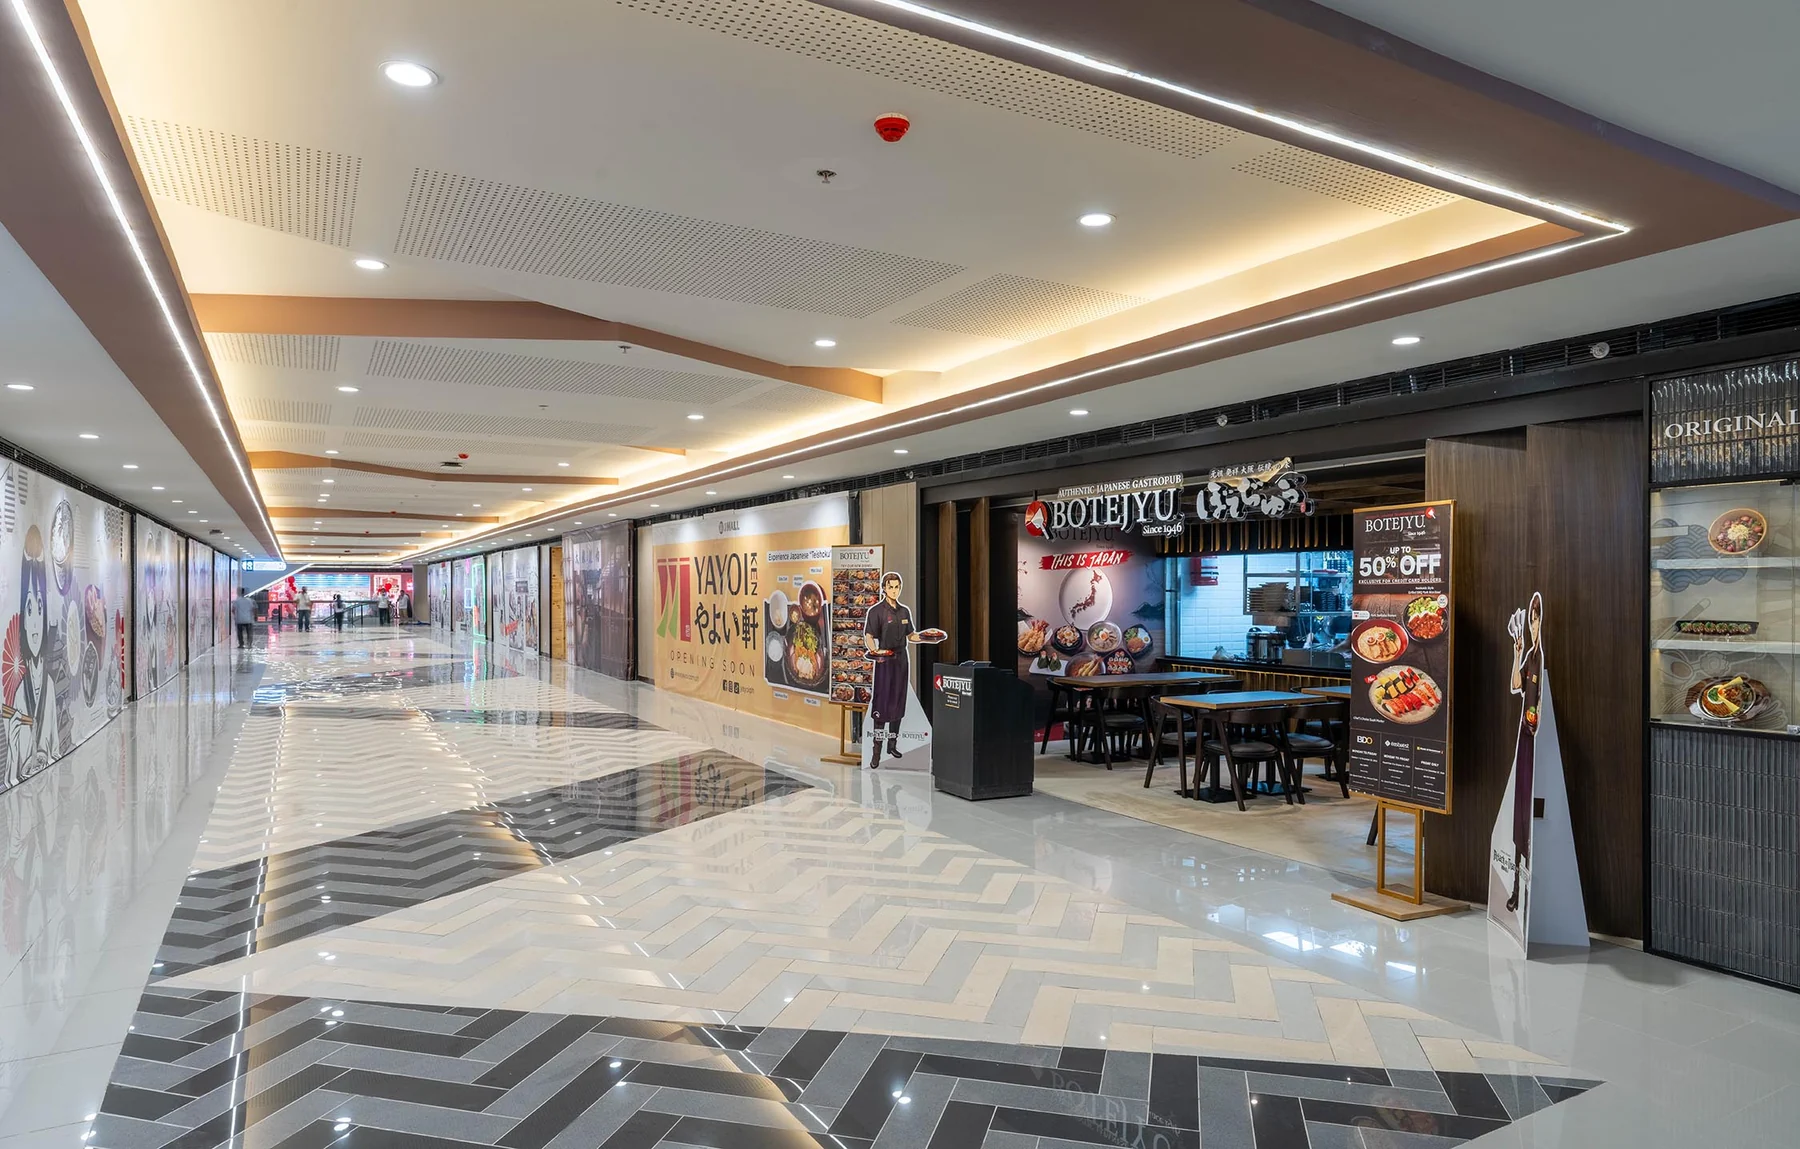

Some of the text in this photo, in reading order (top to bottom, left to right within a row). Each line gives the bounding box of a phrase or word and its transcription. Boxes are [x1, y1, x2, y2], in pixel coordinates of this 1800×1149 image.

[1665, 409, 1800, 439] ORIGINAL
[1058, 474, 1182, 498] AUTHENTIC JAPANESE GASTROPUB
[1142, 522, 1182, 536] Since 1946
[1051, 551, 1124, 569] THIS IS JAPAN
[1401, 546, 1411, 554] TO
[694, 553, 749, 596] YAYOI
[750, 553, 758, 596] KEN
[1359, 554, 1441, 577] 50% OFF
[695, 602, 759, 650] やよい軒
[670, 650, 755, 677] OPENING SOON
[1357, 735, 1373, 744] BDO
